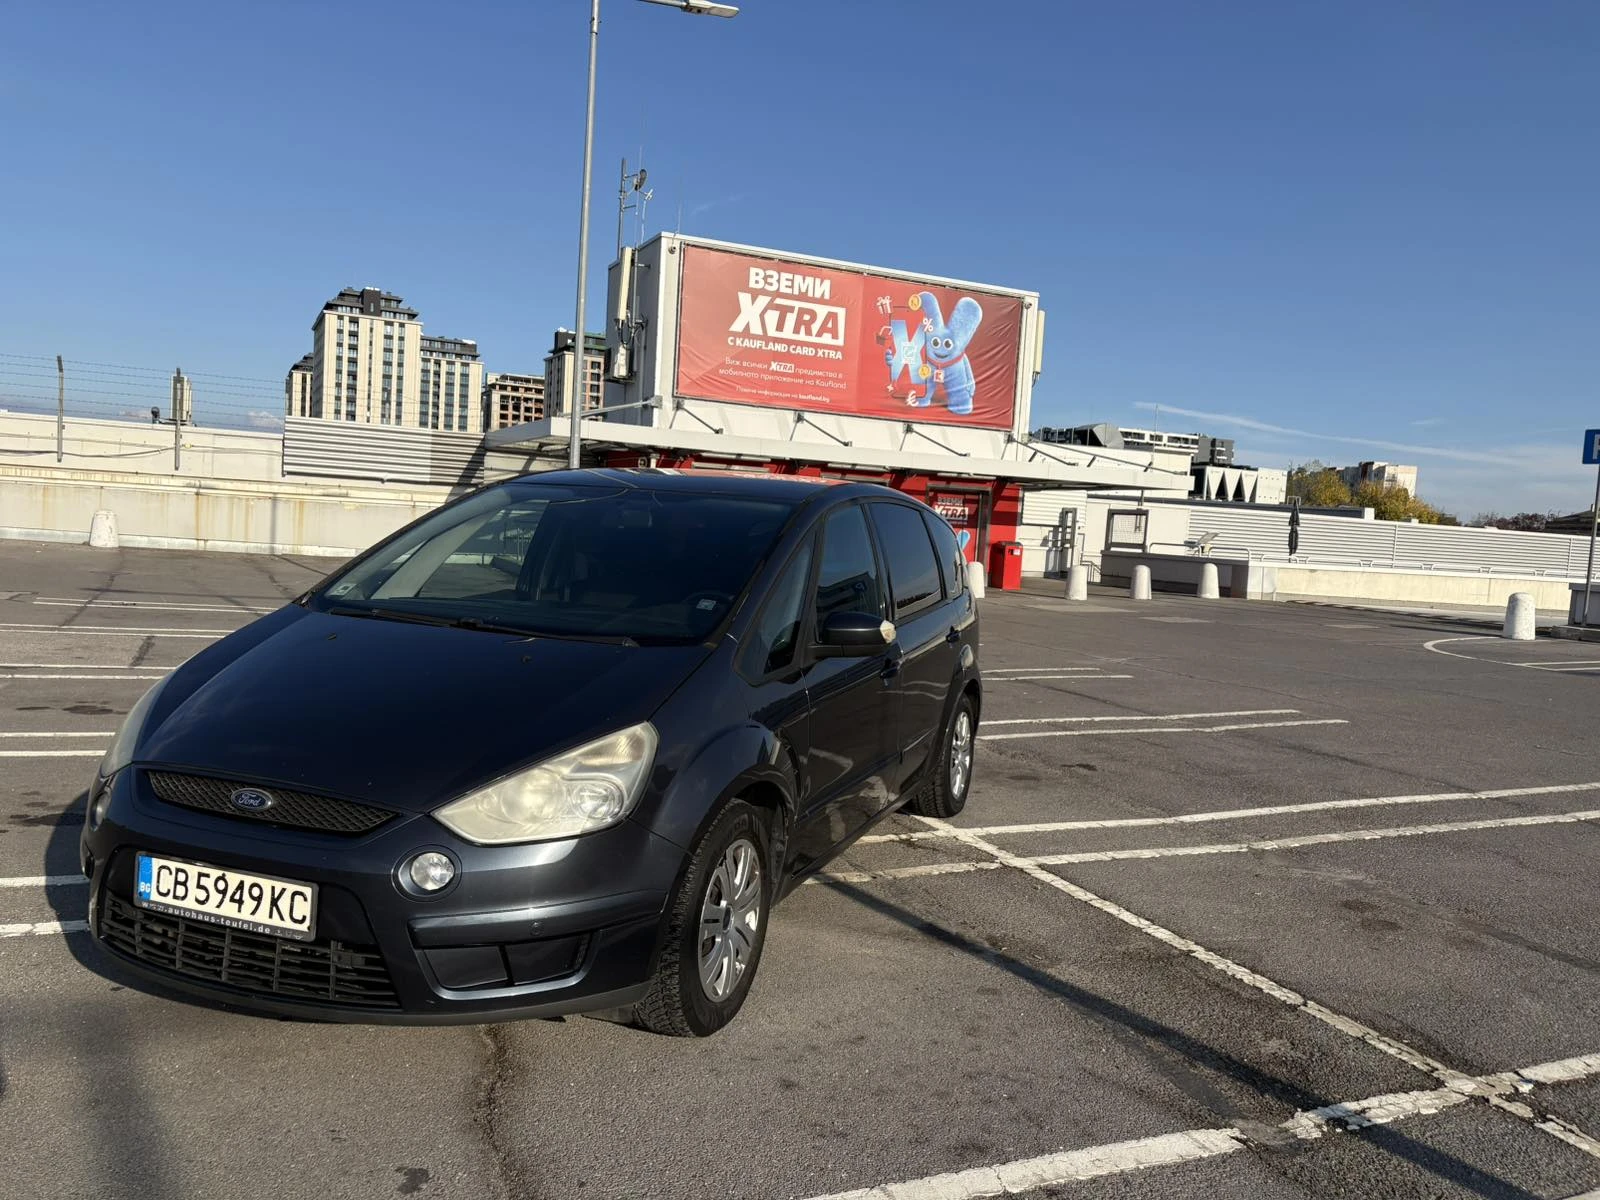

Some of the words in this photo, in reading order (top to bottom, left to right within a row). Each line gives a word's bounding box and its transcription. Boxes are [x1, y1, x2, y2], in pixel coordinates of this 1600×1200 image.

[748, 267, 831, 299] ВЗЕМИ
[727, 336, 735, 346] С
[735, 337, 789, 353] KAUFLAND
[789, 346, 816, 357] CARD
[817, 349, 843, 360] XTRA
[725, 356, 741, 366] Виж
[742, 361, 768, 369] всички
[815, 379, 847, 390] Kaufland
[238, 792, 262, 806] Ford
[139, 881, 151, 893] BG
